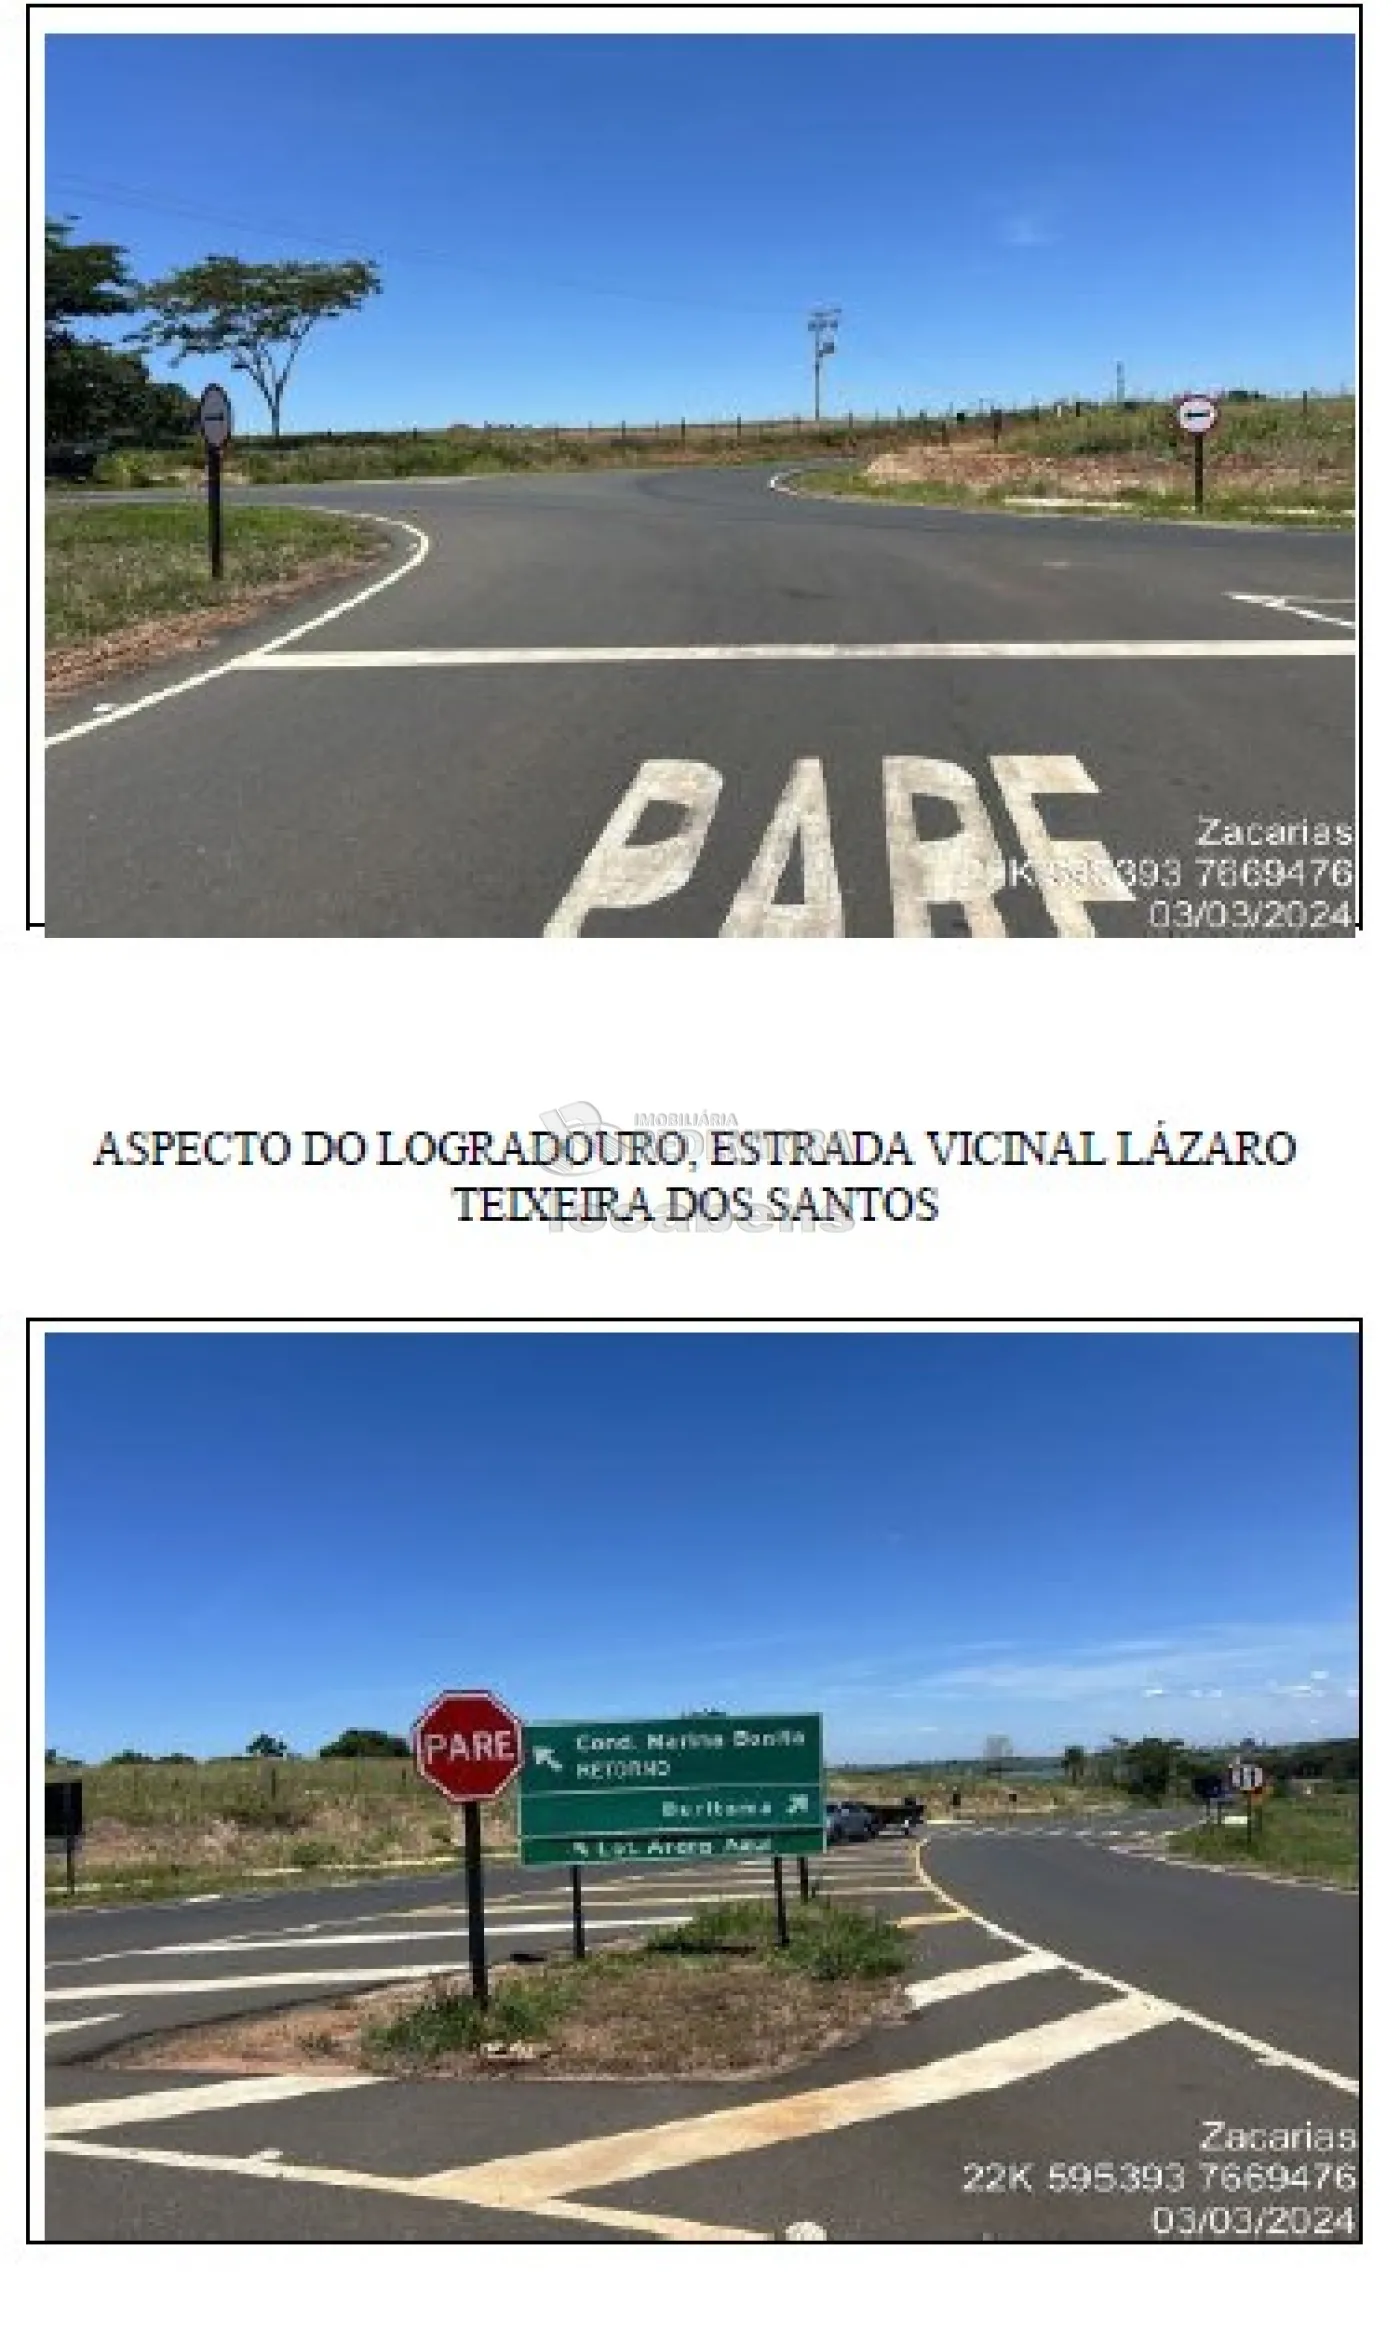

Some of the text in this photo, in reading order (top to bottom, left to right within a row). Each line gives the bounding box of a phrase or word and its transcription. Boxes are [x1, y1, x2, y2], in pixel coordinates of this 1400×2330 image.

[93, 1120, 1298, 1172] ASPECTO DO LOGRADOURO, ESTRADA VICINAL LÁZARO
[451, 1186, 940, 1221] TEIXEIRA DOS SANTOS
[424, 1730, 515, 1765] PARE
[576, 1735, 638, 1751] Cond.
[576, 1759, 671, 1780] RETORNO
